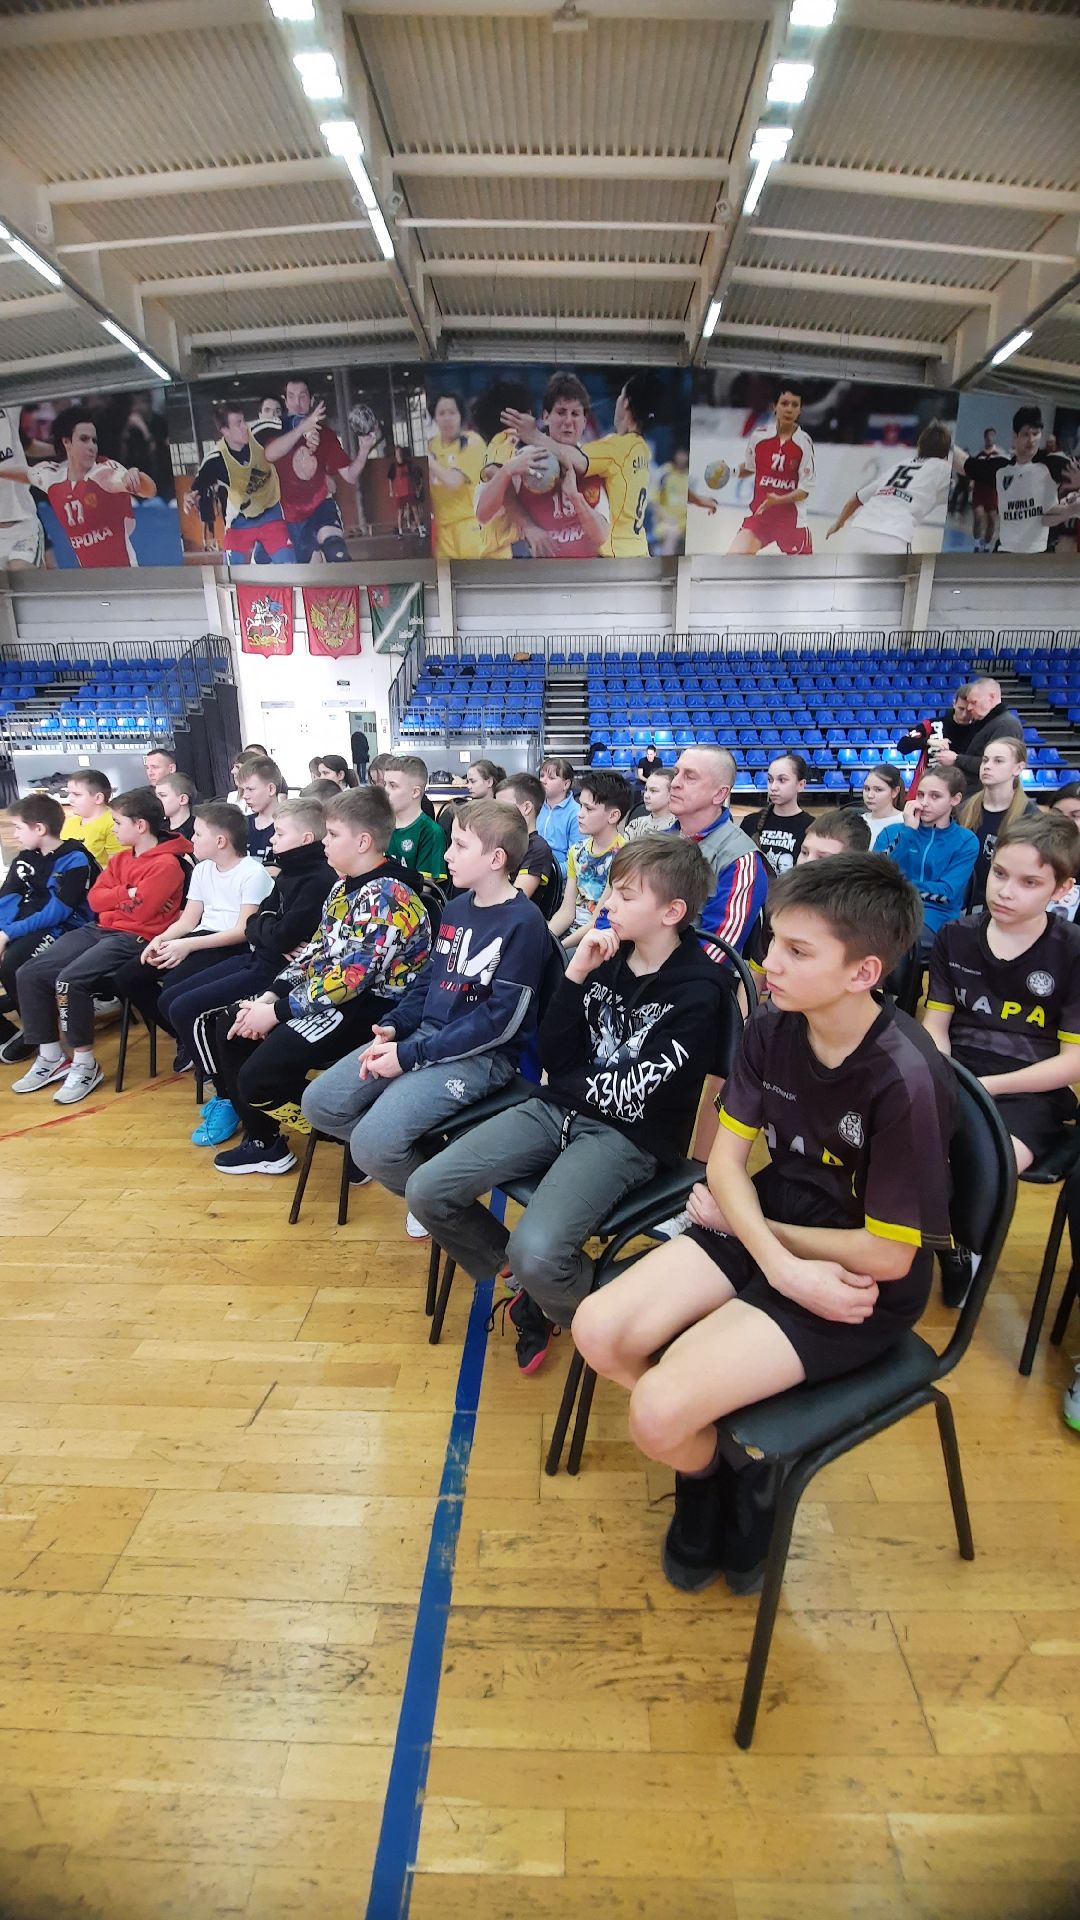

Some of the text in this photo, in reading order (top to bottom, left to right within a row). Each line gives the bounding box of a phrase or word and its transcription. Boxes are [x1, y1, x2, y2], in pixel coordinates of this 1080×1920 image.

[771, 453, 786, 472] 71
[760, 475, 796, 490] EPOKA
[885, 465, 923, 489] 15
[1007, 498, 1035, 511] WORLD
[64, 500, 85, 527] 17
[761, 830, 794, 841] TEAM
